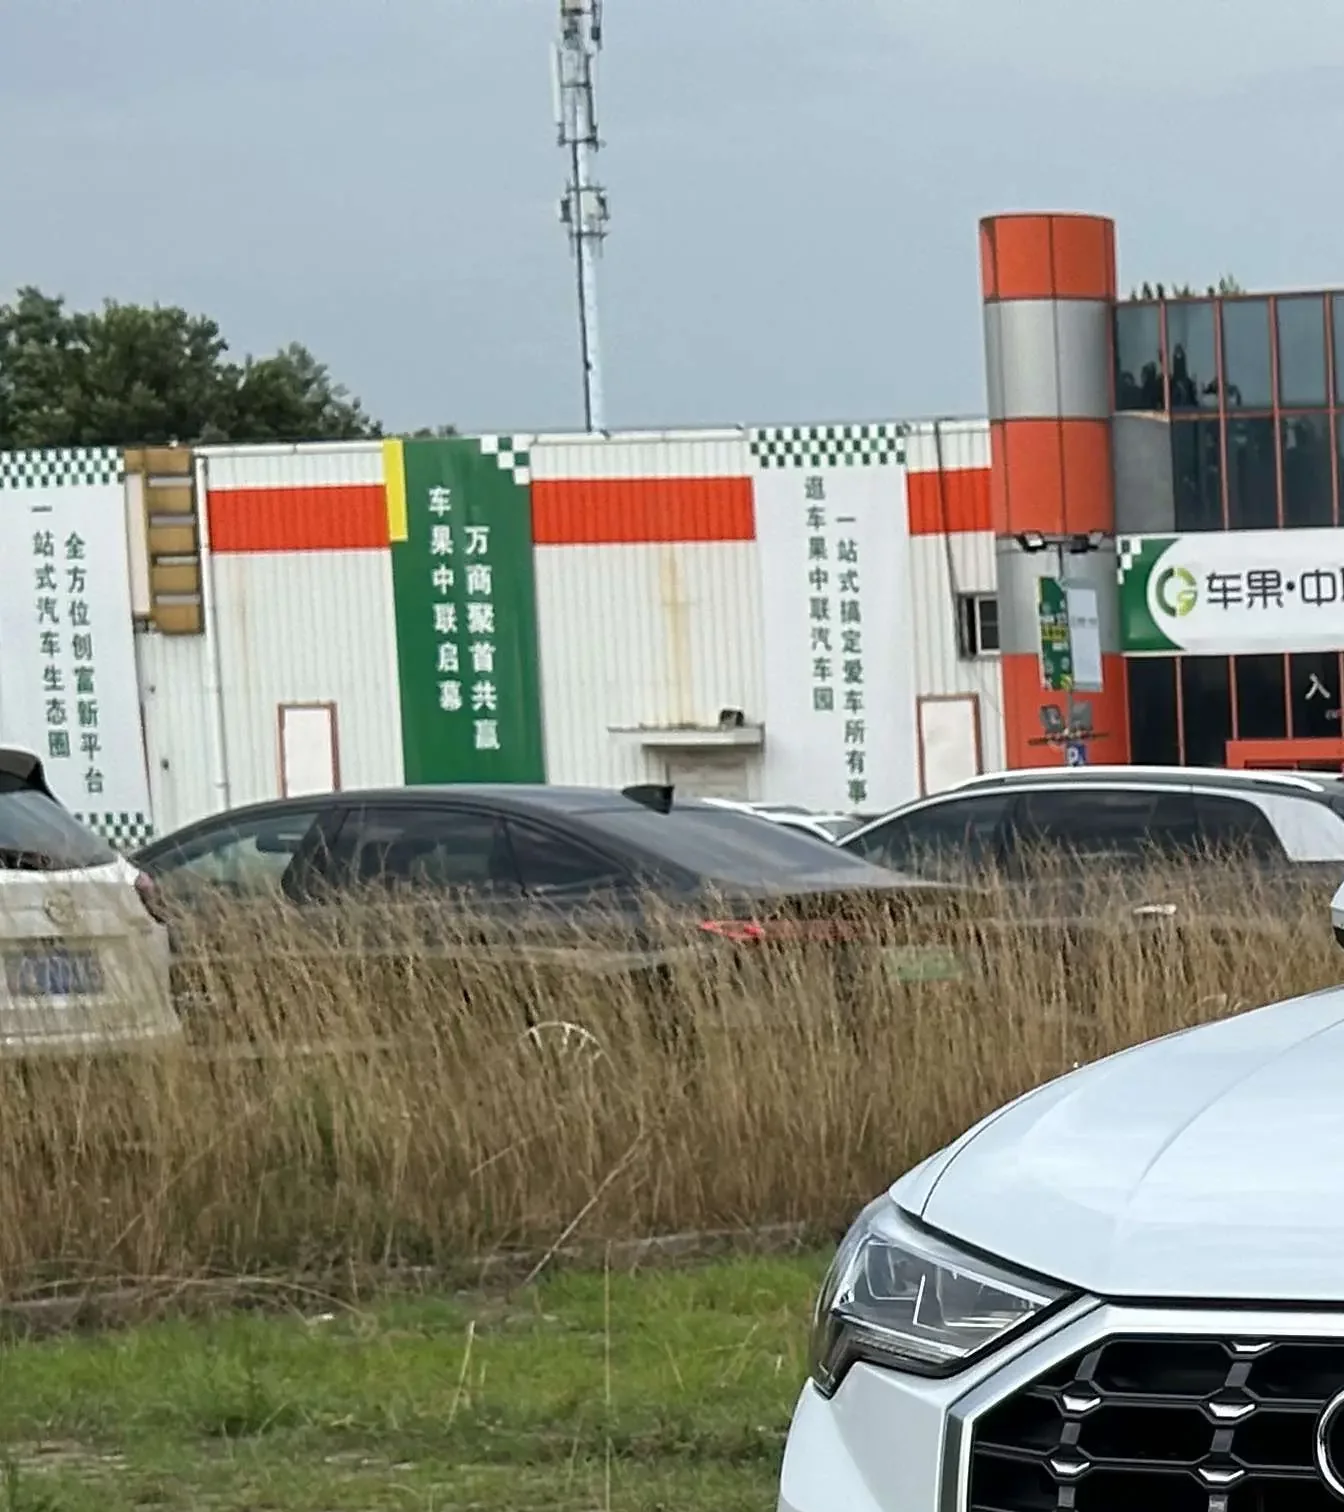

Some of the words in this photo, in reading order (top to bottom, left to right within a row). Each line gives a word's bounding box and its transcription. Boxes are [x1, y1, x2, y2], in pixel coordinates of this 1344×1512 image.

[31, 504, 71, 758] 一站式汽车生态圈
[63, 531, 105, 794] 全方位创富新平台
[428, 484, 463, 711] 车果中联启幕
[463, 525, 501, 750] 万商聚首共赢
[804, 475, 834, 711] 逛车果中联汽车园
[835, 516, 867, 805] 一站式搞定爱车所有事
